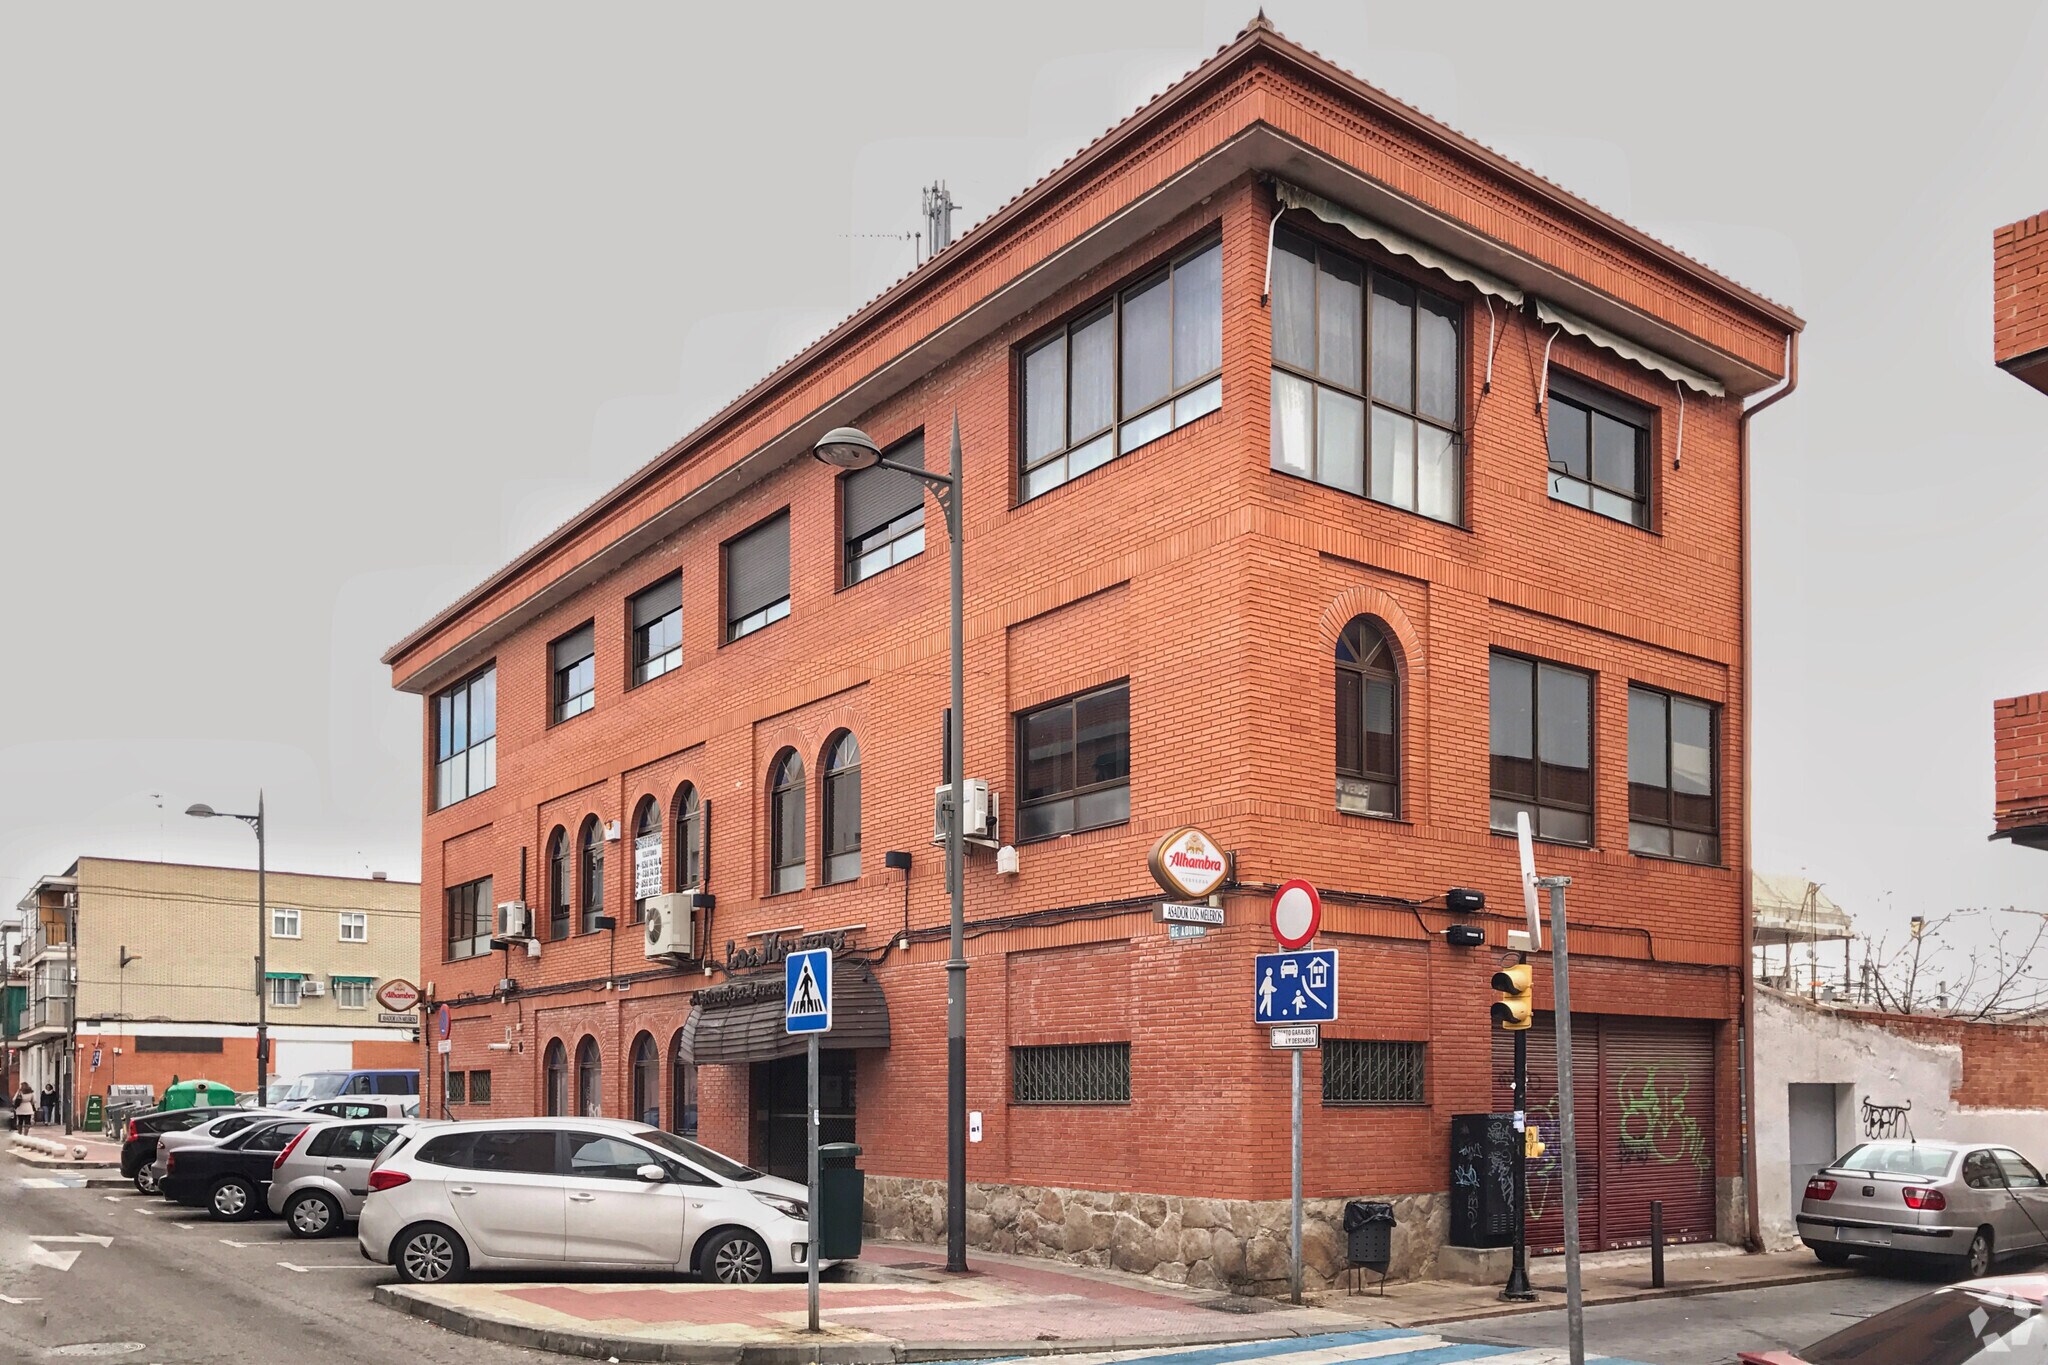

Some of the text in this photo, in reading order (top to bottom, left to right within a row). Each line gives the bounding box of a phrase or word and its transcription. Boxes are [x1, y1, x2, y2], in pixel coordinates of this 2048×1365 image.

[1169, 852, 1221, 871] Alhambra
[1168, 906, 1223, 922] ASADOR LOS MELEROS
[1171, 926, 1179, 937] DE
[385, 991, 415, 999] Alhambra
